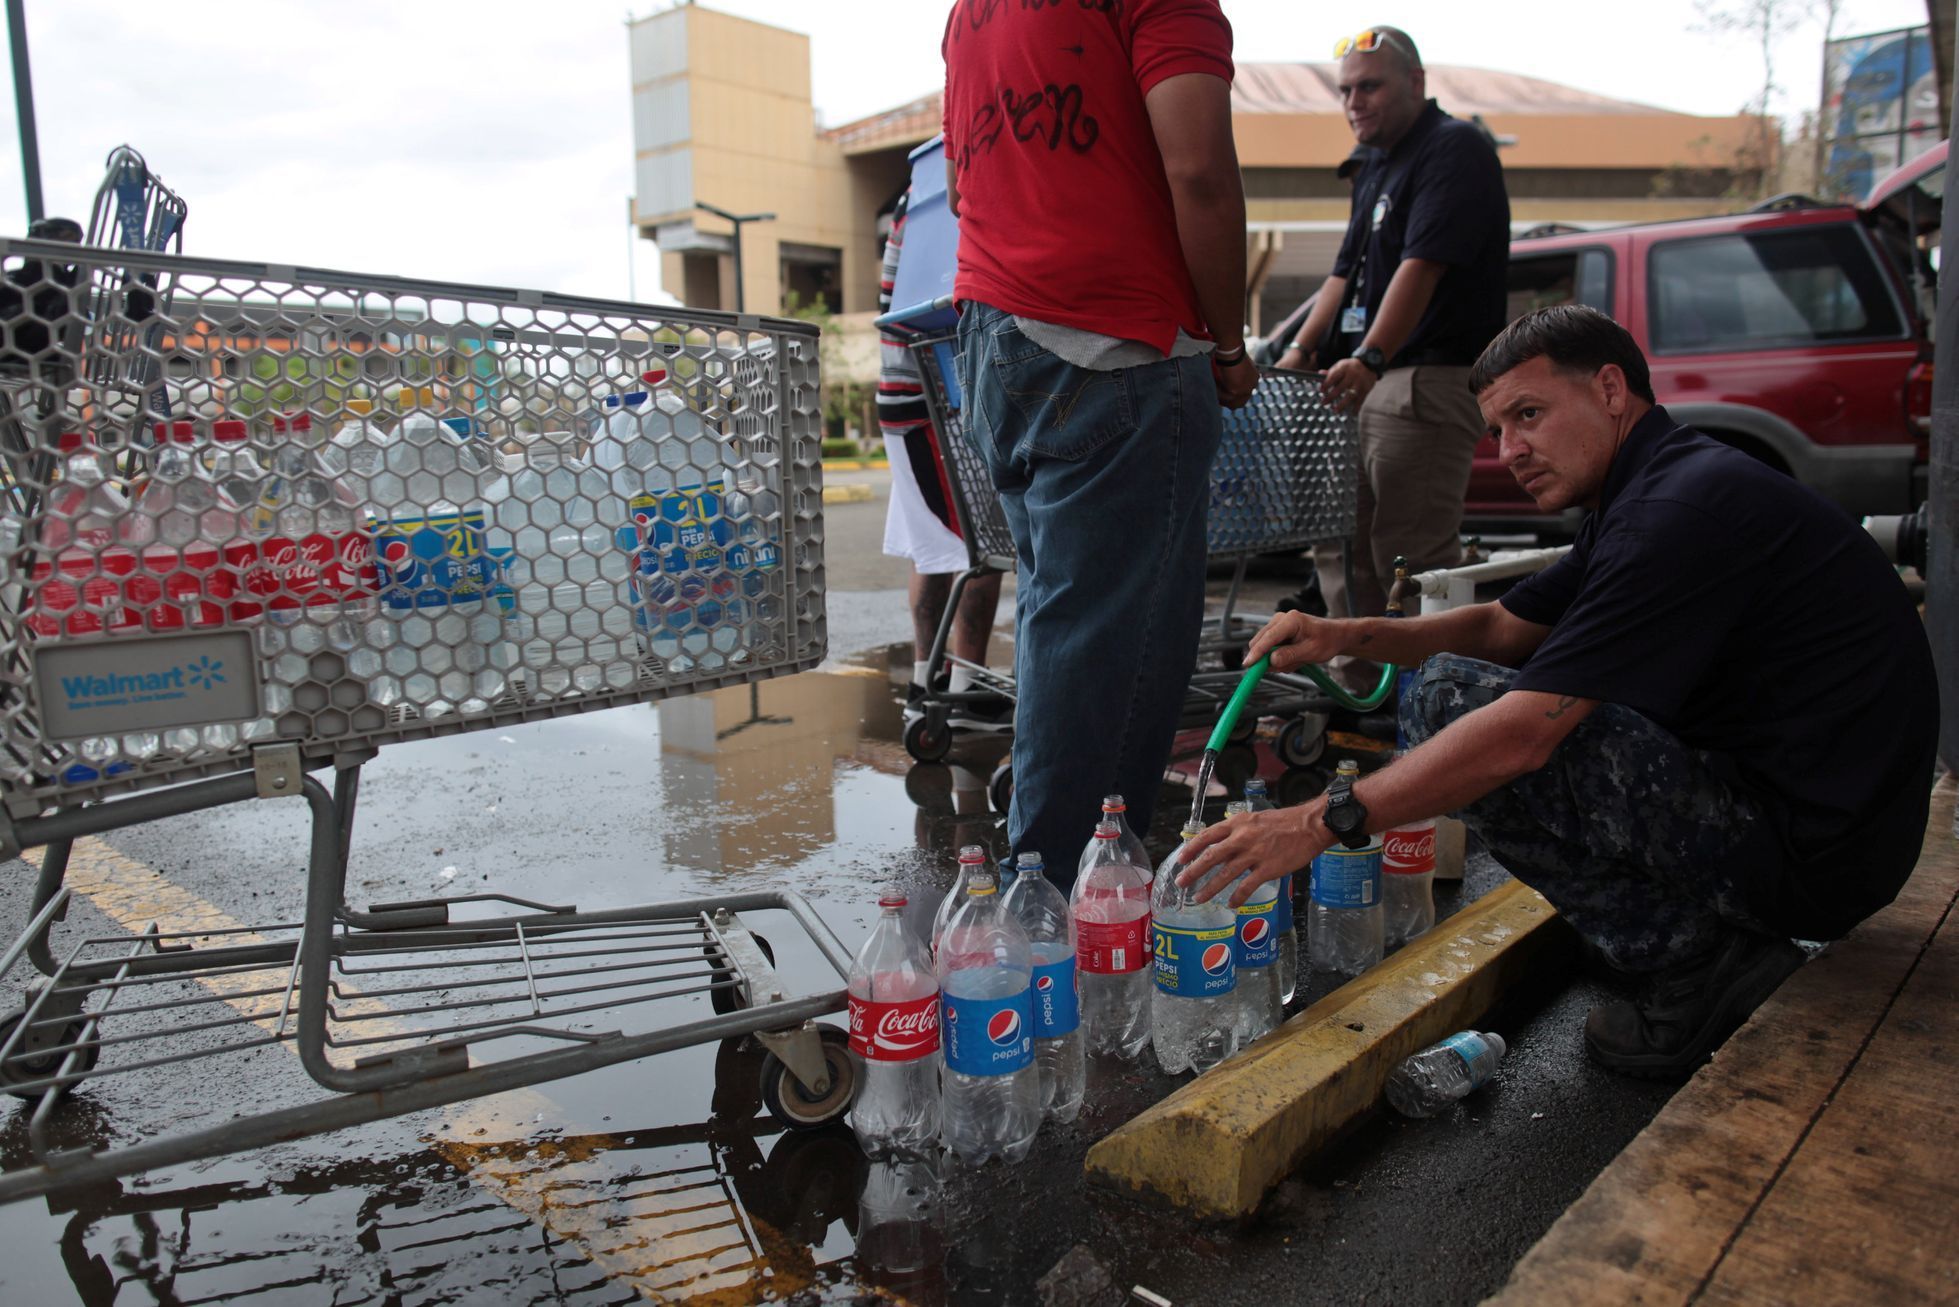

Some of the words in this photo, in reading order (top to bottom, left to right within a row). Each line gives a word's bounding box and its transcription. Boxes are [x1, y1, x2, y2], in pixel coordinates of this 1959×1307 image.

[681, 531, 716, 548] PEPI
[685, 550, 721, 562] PECIO
[61, 666, 185, 699] Walmart
[1155, 933, 1179, 960] 2L
[1245, 951, 1268, 961] pepsi
[1155, 960, 1177, 974] PEPSI
[1205, 977, 1228, 990] pepsi
[1041, 993, 1054, 1026] pepsi
[950, 1024, 959, 1059] pepsi
[992, 1046, 1021, 1062] pepsi
